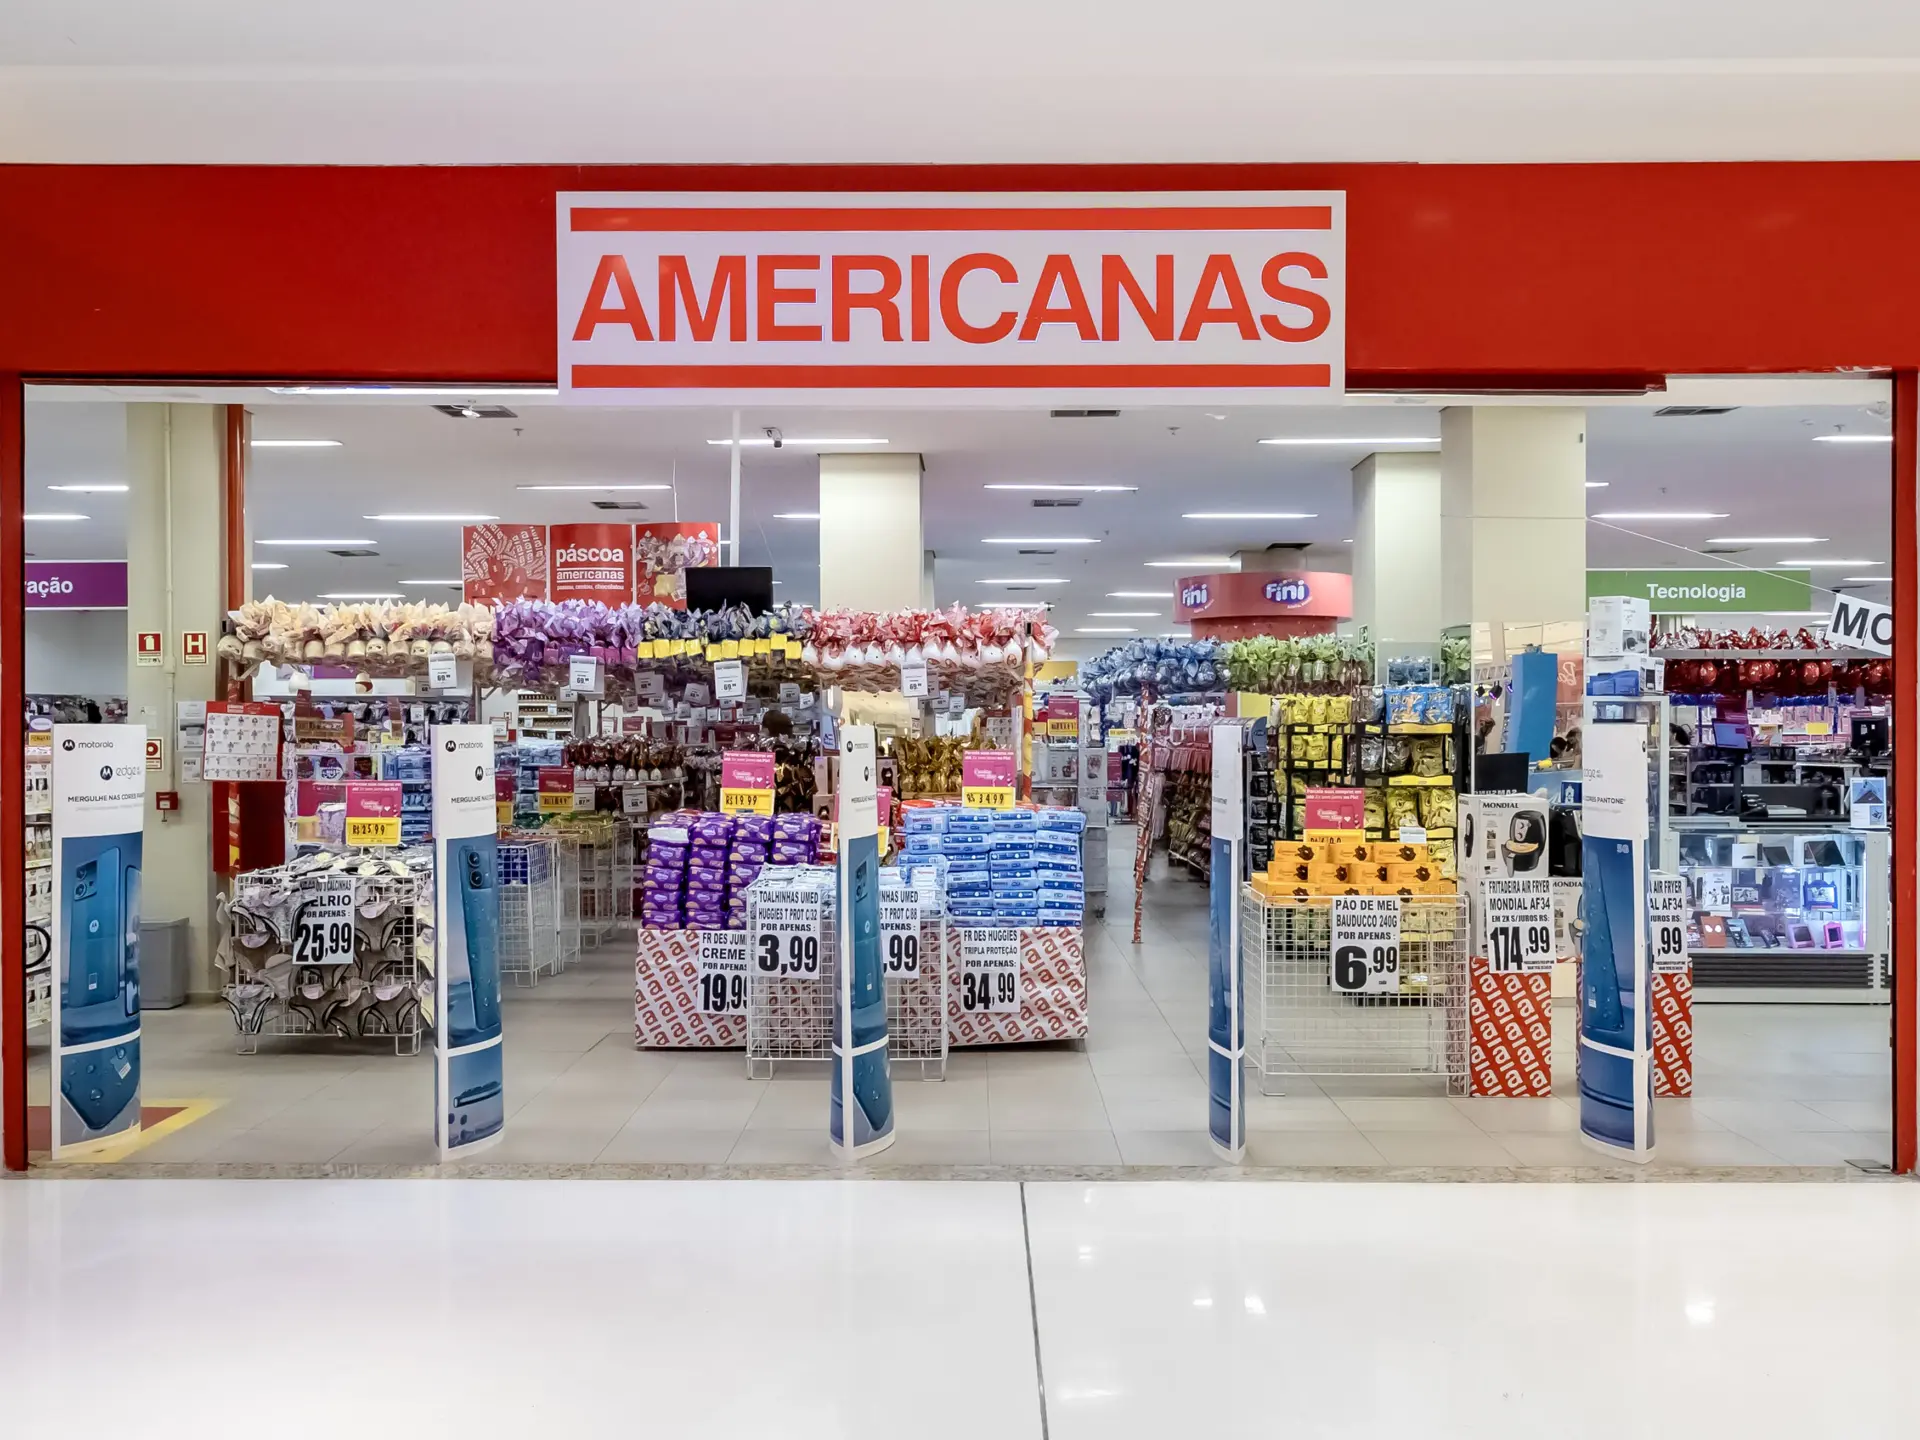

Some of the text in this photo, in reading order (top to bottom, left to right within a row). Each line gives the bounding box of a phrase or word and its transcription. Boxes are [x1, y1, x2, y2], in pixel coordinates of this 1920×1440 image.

[572, 253, 1331, 343] AMERICANAS
[556, 543, 624, 567] páscoa
[557, 571, 624, 580] americanas
[25, 577, 73, 598] ação
[1266, 580, 1305, 602] Fini
[1646, 583, 1746, 602] Tecnologia
[1182, 584, 1207, 607] Fini
[186, 634, 204, 653] H
[78, 741, 114, 749] motorola
[68, 795, 108, 803] MERGULHE
[1489, 880, 1550, 894] FRITADEIRA AIR FRYER
[1654, 880, 1663, 894] AIR
[1664, 880, 1682, 894] FRYER
[759, 890, 819, 904] TOALHINHAS UMED
[900, 891, 919, 903] UMED
[1335, 897, 1399, 911] PÃO DE MEL
[1489, 897, 1550, 911] MONDIAL AF34
[1662, 898, 1682, 910] AF34
[318, 910, 346, 918] APENAS
[758, 908, 784, 921] HUGGIES
[790, 908, 804, 920] PROT
[890, 908, 905, 920] PROT
[1336, 914, 1398, 928] BAUDUCCO 240G
[761, 923, 777, 931] POR
[779, 923, 812, 932] APENAS
[296, 922, 352, 962] 25,99
[702, 933, 747, 945] FR DES JUM
[964, 930, 1017, 941] FR DES HUGGIES
[1337, 931, 1356, 940] POR
[1357, 931, 1391, 940] APENAS
[702, 948, 745, 960] CREME
[758, 934, 818, 975] 3,99
[964, 945, 1018, 957] TRIPLA PROTEÇÃO
[1490, 926, 1551, 971] 174,99
[703, 962, 718, 970] POR
[965, 960, 982, 968] POR
[1335, 945, 1398, 990] 6,99
[963, 972, 1015, 1011] 34,99
